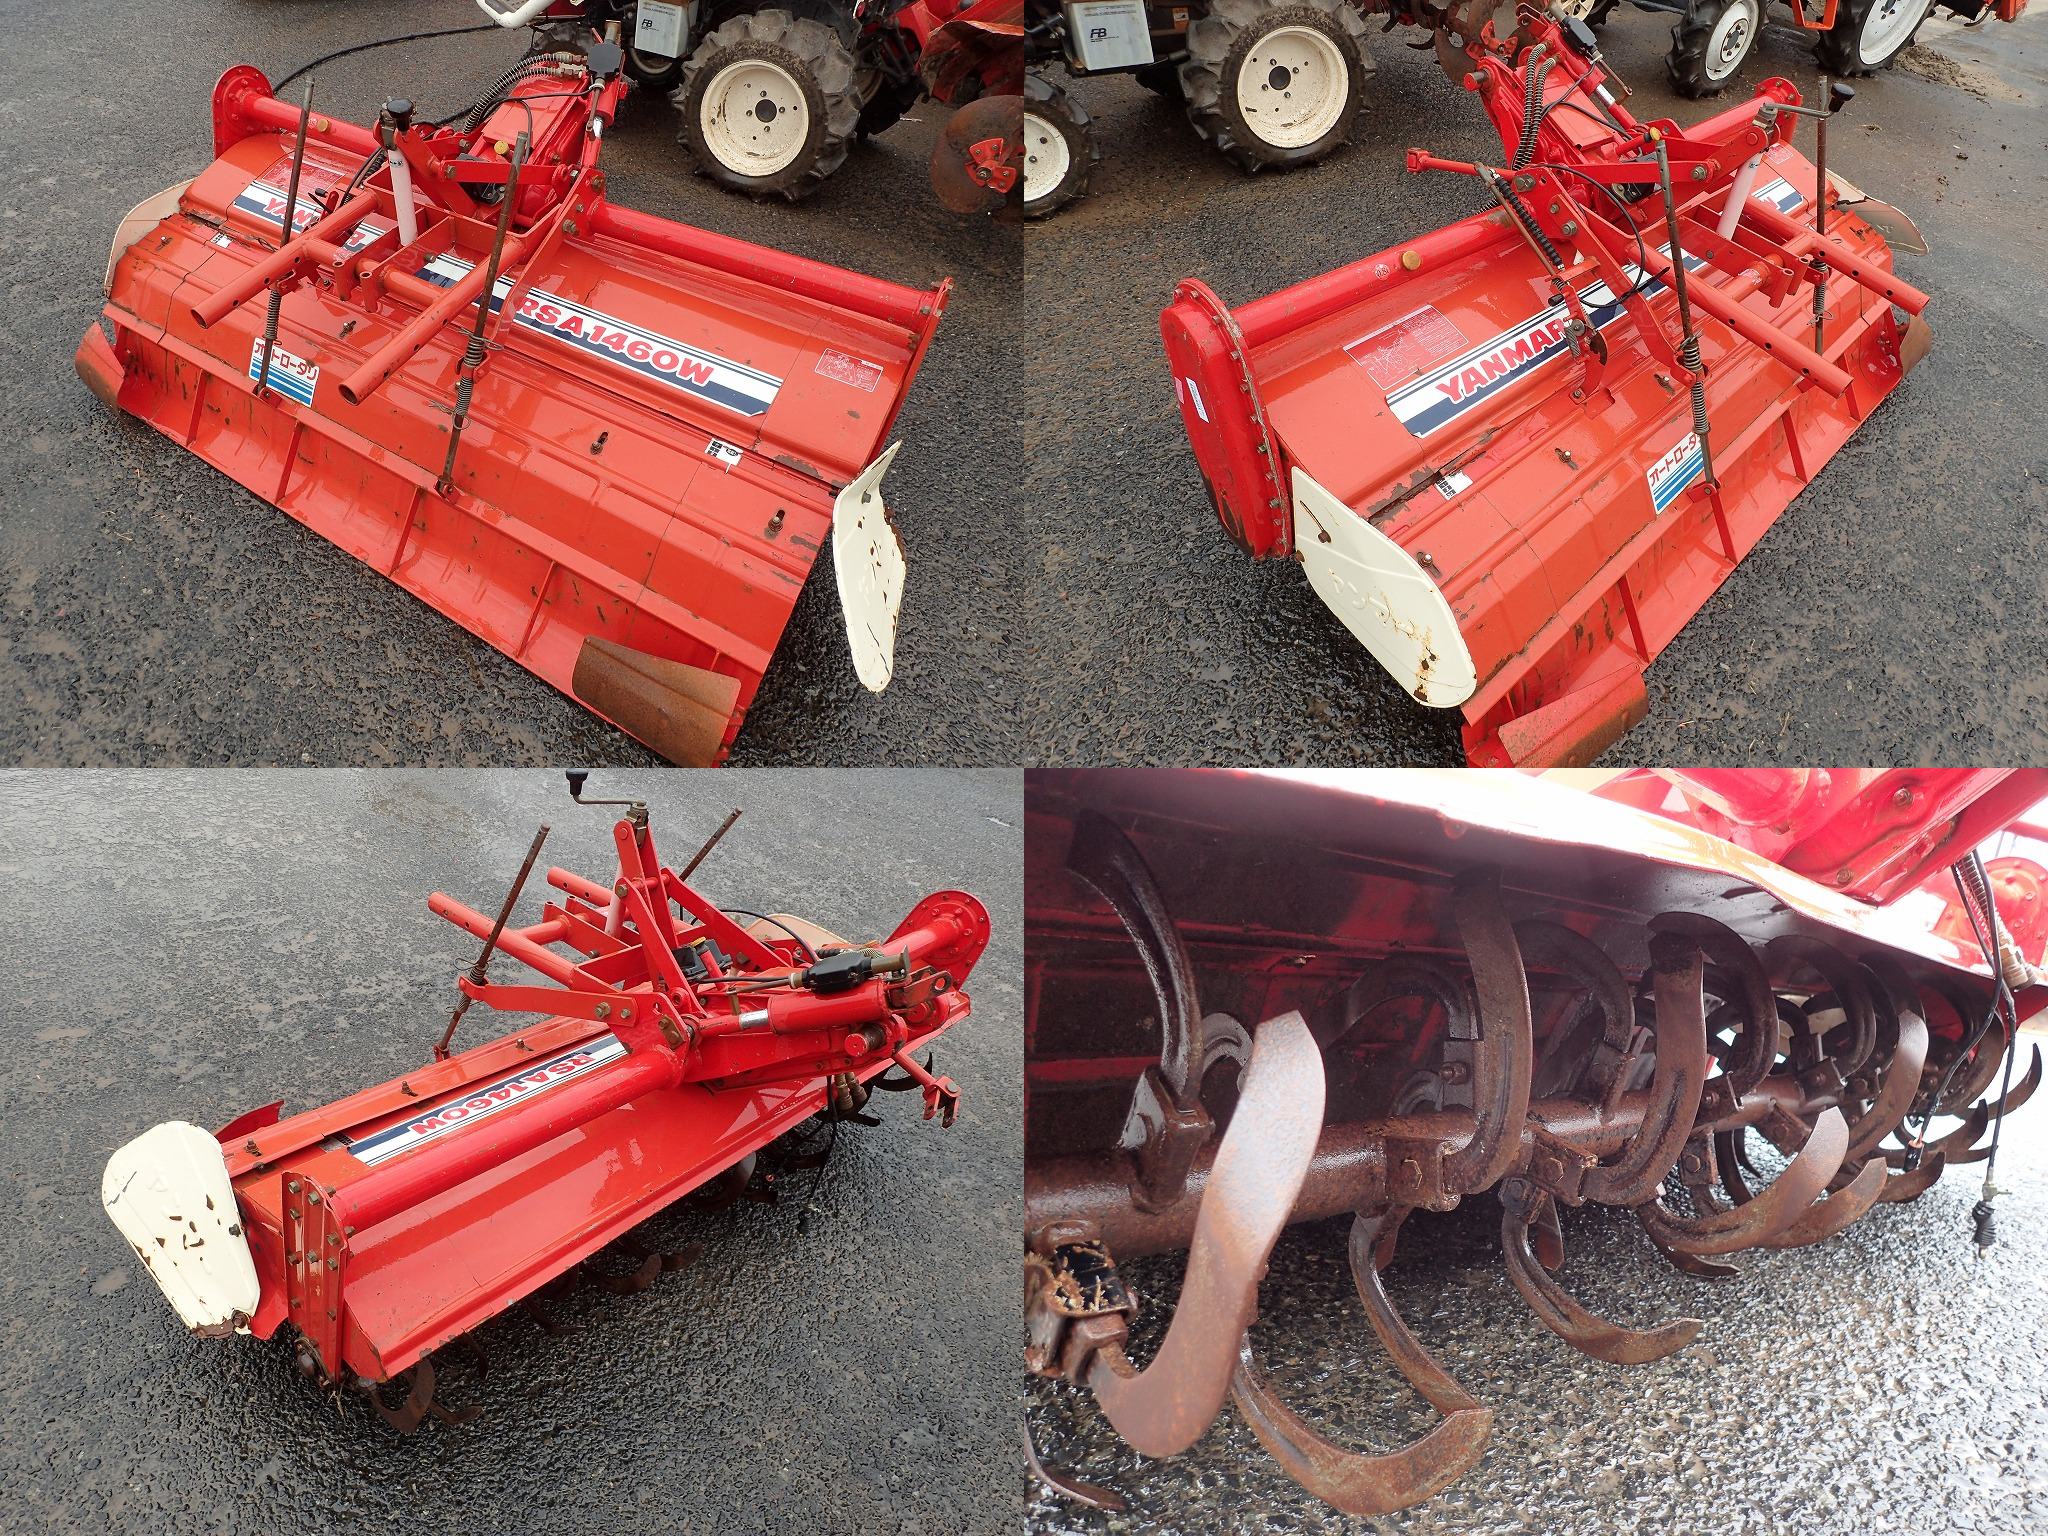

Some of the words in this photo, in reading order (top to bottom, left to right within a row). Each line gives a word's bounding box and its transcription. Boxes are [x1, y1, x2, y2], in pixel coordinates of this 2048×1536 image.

[254, 342, 318, 381] オトロータリ
[517, 299, 715, 386] RSA1460W
[1648, 433, 1699, 488] オートロータ
[409, 1053, 597, 1135] RSA1460W
